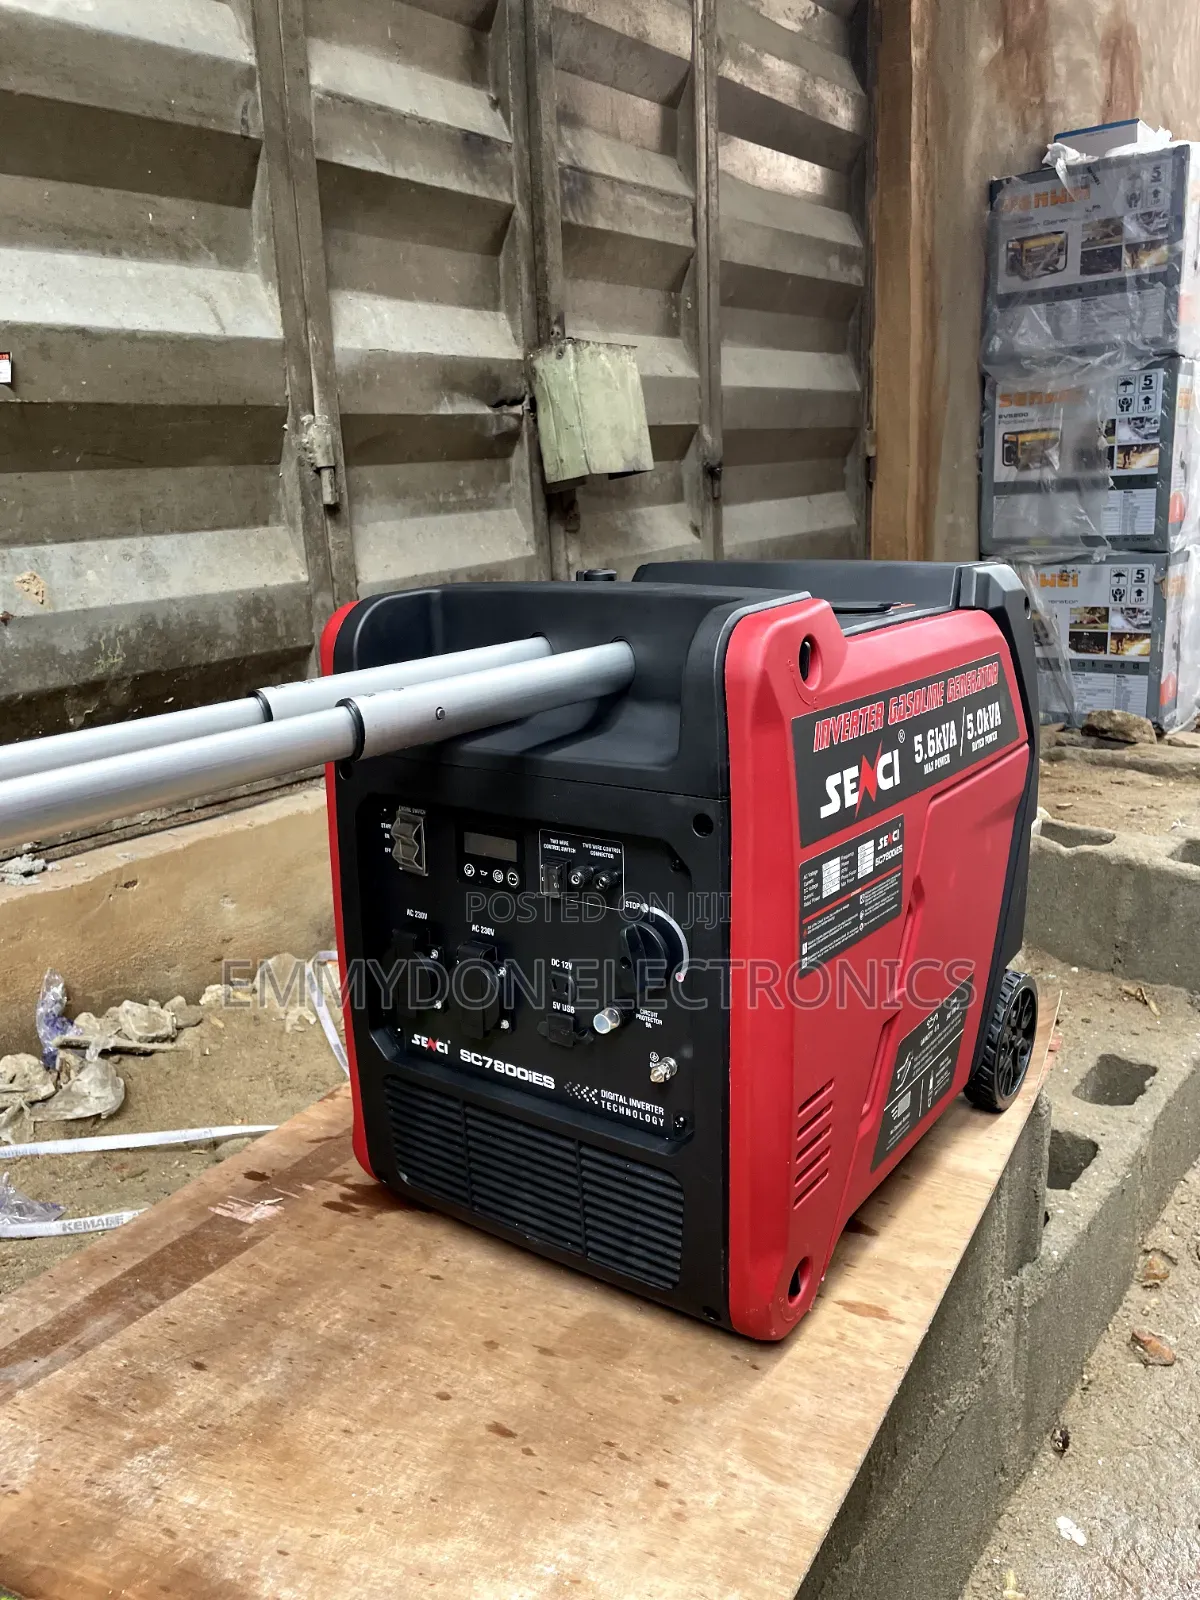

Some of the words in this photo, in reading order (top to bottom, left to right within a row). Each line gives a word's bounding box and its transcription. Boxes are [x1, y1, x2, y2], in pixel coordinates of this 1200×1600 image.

[1143, 374, 1153, 386] 5
[1136, 569, 1145, 580] 5
[813, 701, 885, 752] INVERTER
[888, 681, 945, 726] GASOLINE
[946, 661, 999, 704] GENERATOR
[914, 720, 957, 763] 5.6kVA
[966, 701, 1002, 740] 5.0kVA
[971, 737, 985, 752] RATED
[985, 730, 998, 745] POWER
[923, 760, 934, 775] MAX
[935, 753, 951, 769] POWER
[820, 740, 901, 819] SENCI
[877, 829, 900, 850] SENCI
[406, 908, 414, 917] AC
[414, 910, 428, 920] 230V
[625, 900, 640, 910] STOP
[471, 923, 480, 933] AC
[480, 925, 495, 937] 230V
[551, 958, 561, 967] DC
[561, 960, 573, 971] 12V
[552, 1001, 561, 1010] 5V
[562, 1003, 576, 1014] USB
[640, 1008, 658, 1018] CIRCUIT
[635, 1013, 663, 1026] PROTECTOR
[411, 1033, 449, 1055] SENCI
[459, 1048, 556, 1090] SC7800iES
[600, 1089, 629, 1105] DIGITAL
[629, 1097, 665, 1116] INVERTER
[601, 1099, 665, 1127] TECHNOLOGY
